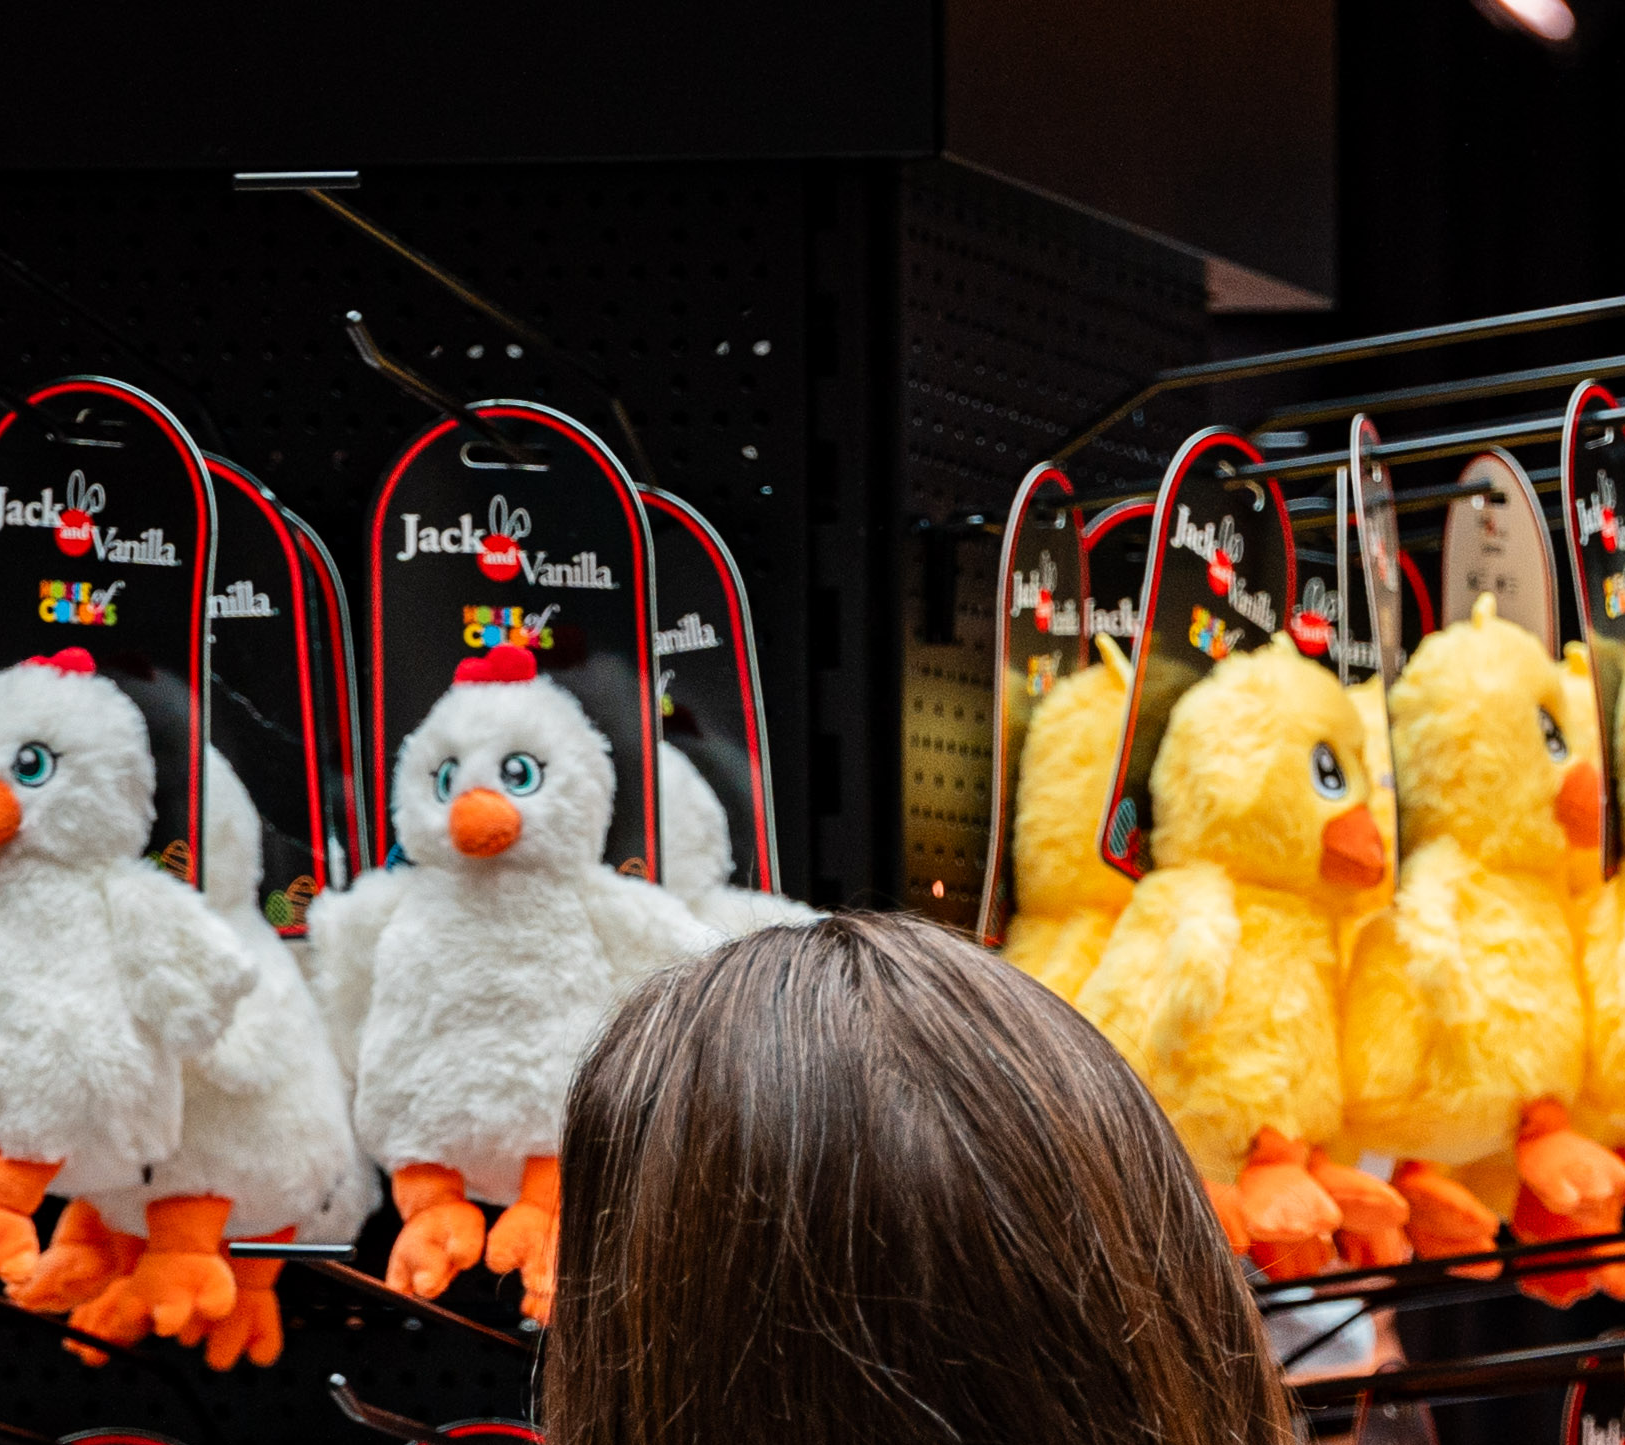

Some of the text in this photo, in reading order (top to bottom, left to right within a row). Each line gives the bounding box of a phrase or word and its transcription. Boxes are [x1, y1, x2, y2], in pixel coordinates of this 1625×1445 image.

[59, 525, 91, 541] and
[90, 526, 177, 566] Vanilla
[396, 513, 613, 590] Jack and Vanilla
[207, 580, 274, 618] nilla
[653, 612, 719, 655] anilla
